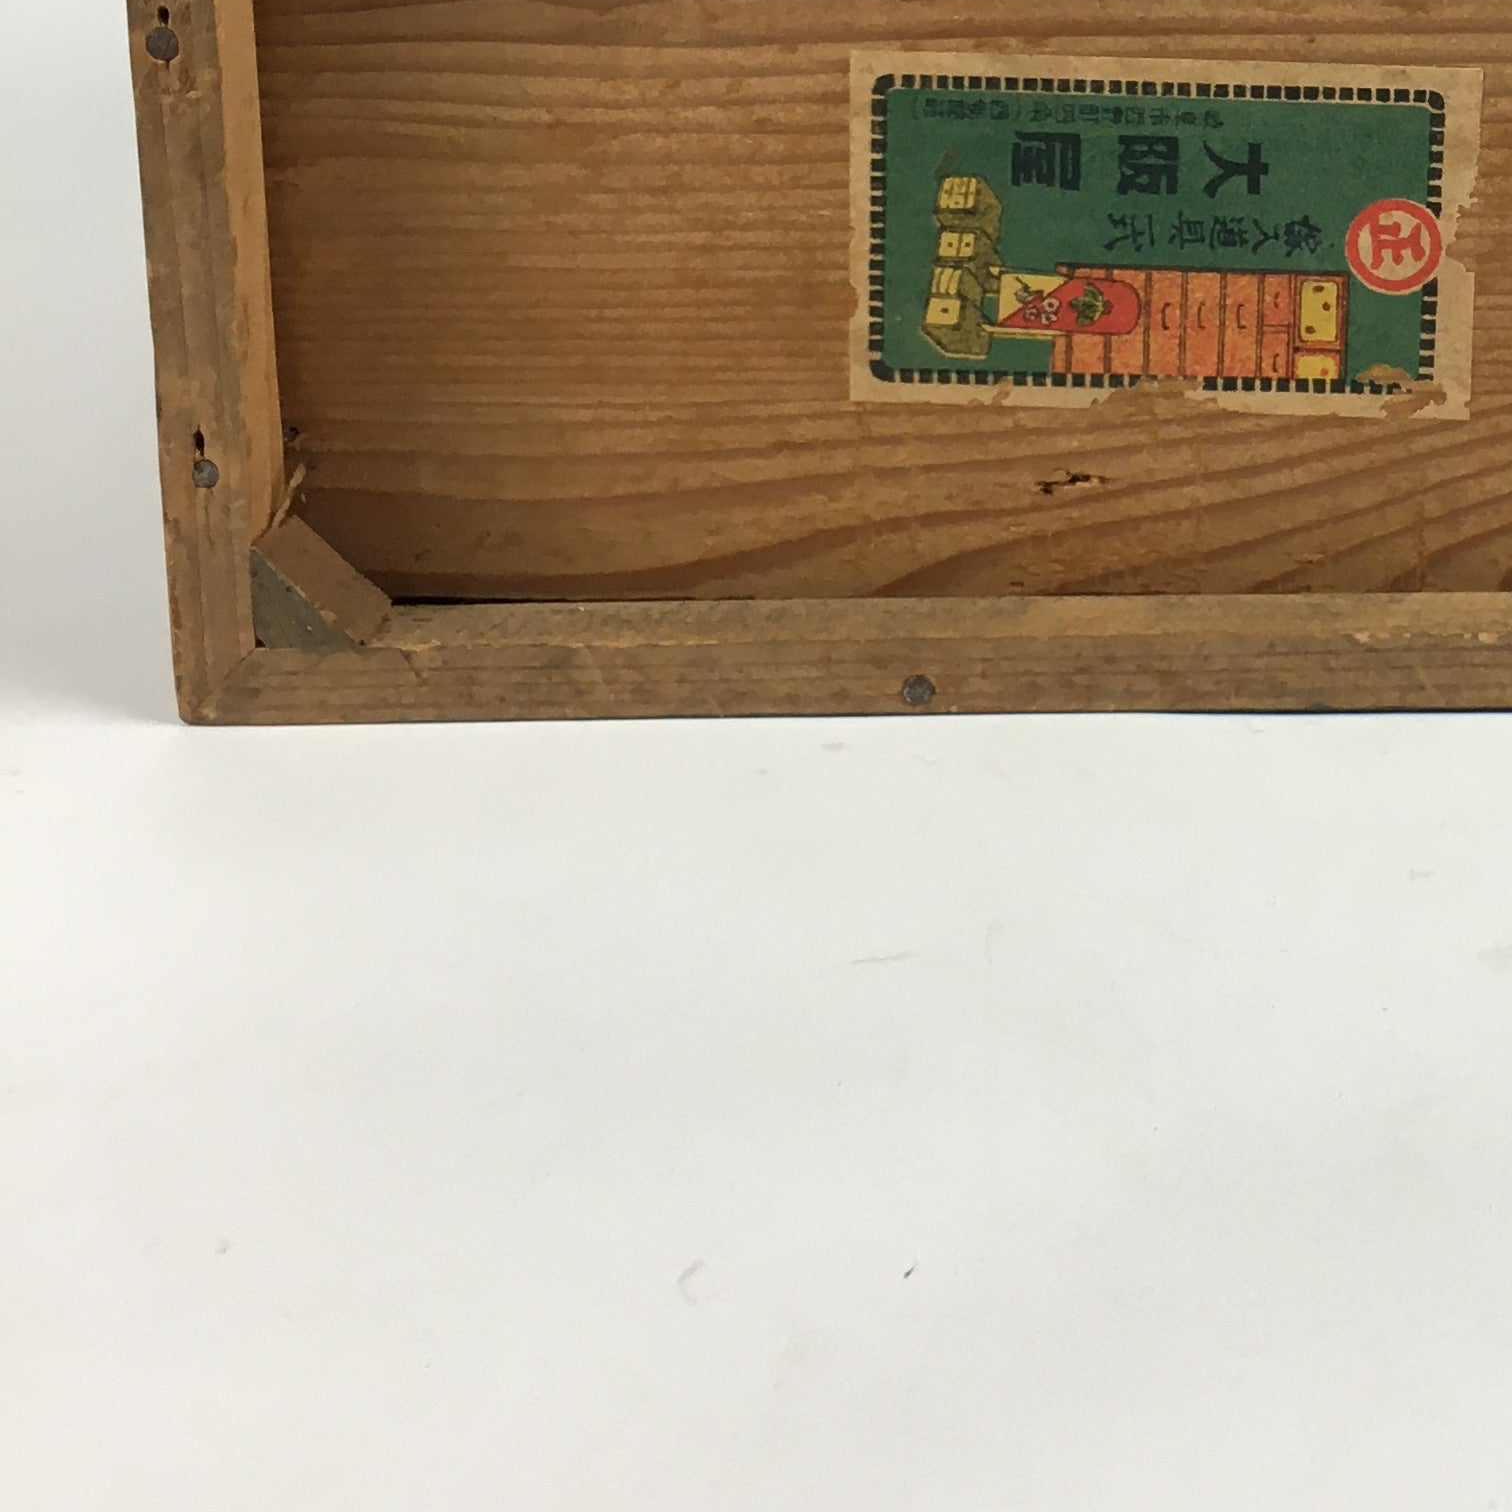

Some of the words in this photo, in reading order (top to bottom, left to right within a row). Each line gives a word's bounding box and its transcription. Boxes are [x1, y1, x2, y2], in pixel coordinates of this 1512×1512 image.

[1011, 130, 1270, 199] 大阪屋
[1104, 209, 1323, 257] 嫁入道具一式
